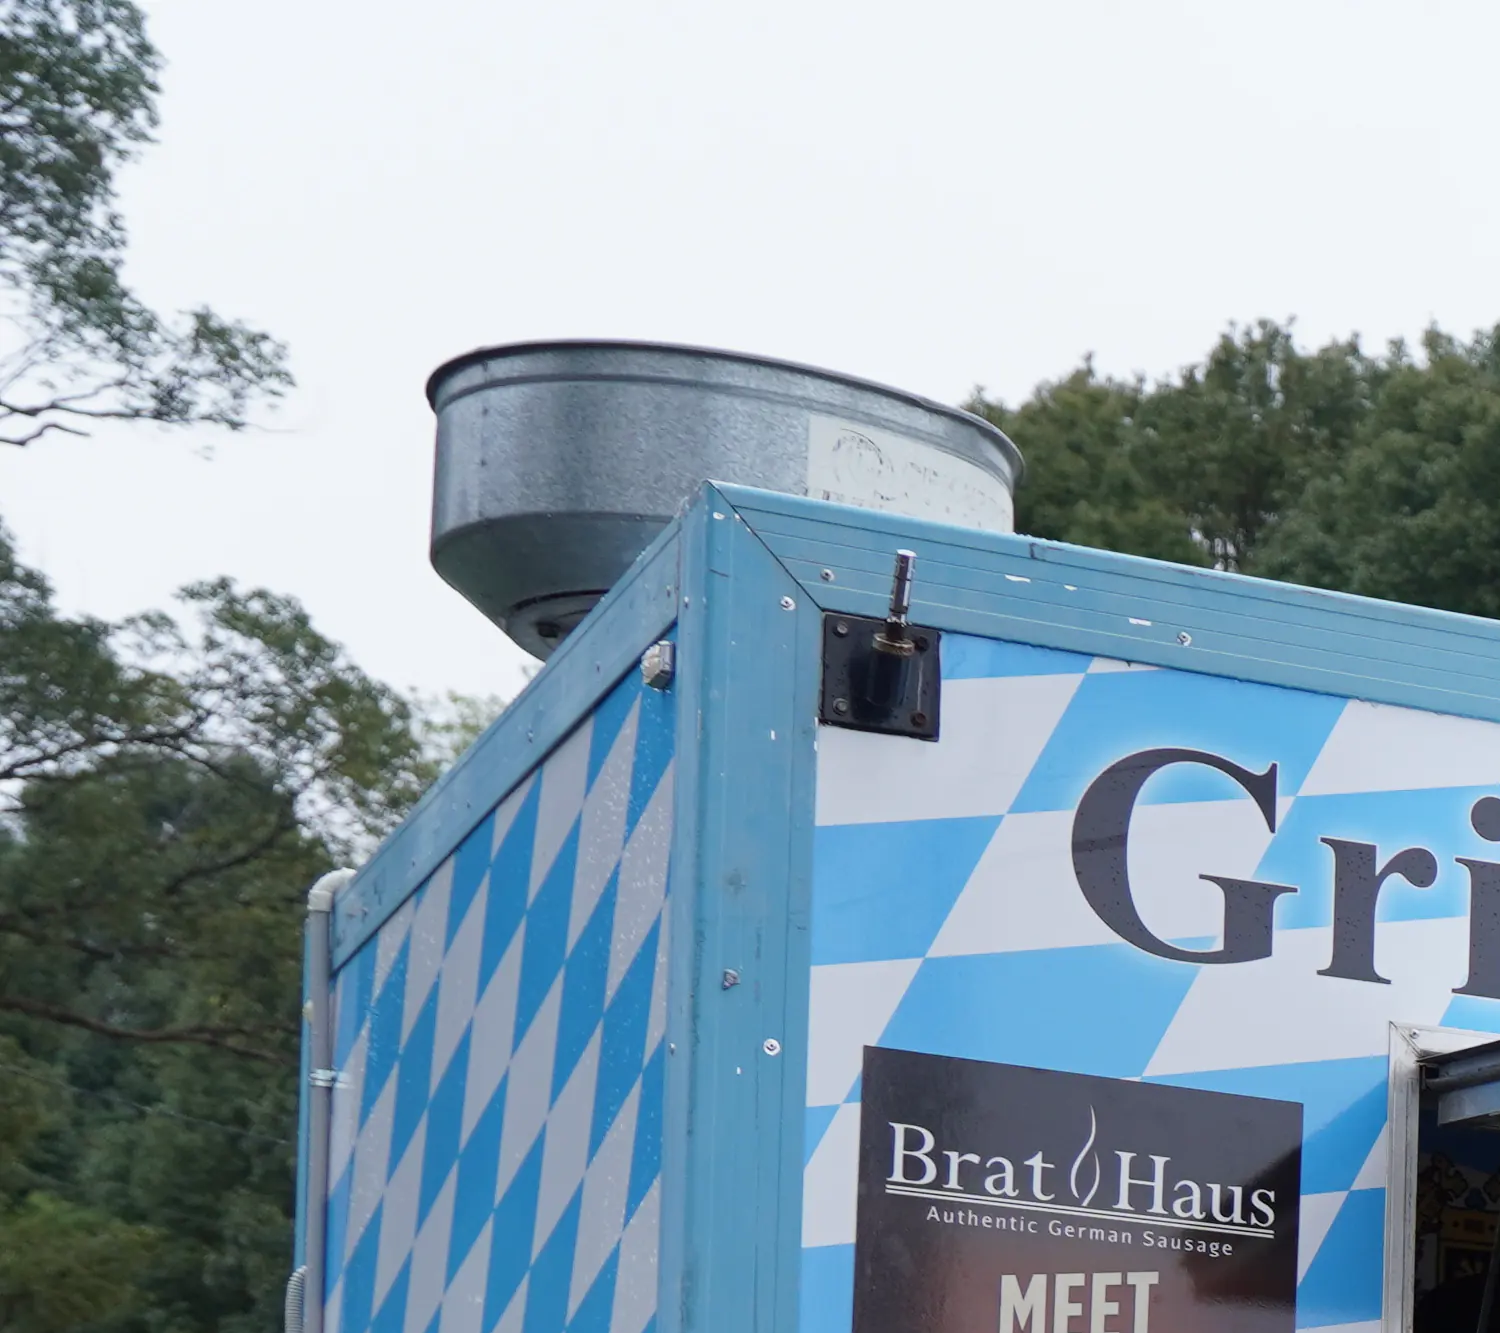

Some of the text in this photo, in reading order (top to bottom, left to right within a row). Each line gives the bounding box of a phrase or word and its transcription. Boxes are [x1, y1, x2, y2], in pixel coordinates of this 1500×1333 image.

[886, 1121, 1275, 1229] Brat Haus
[926, 1205, 1234, 1261] Authentic German Sausage
